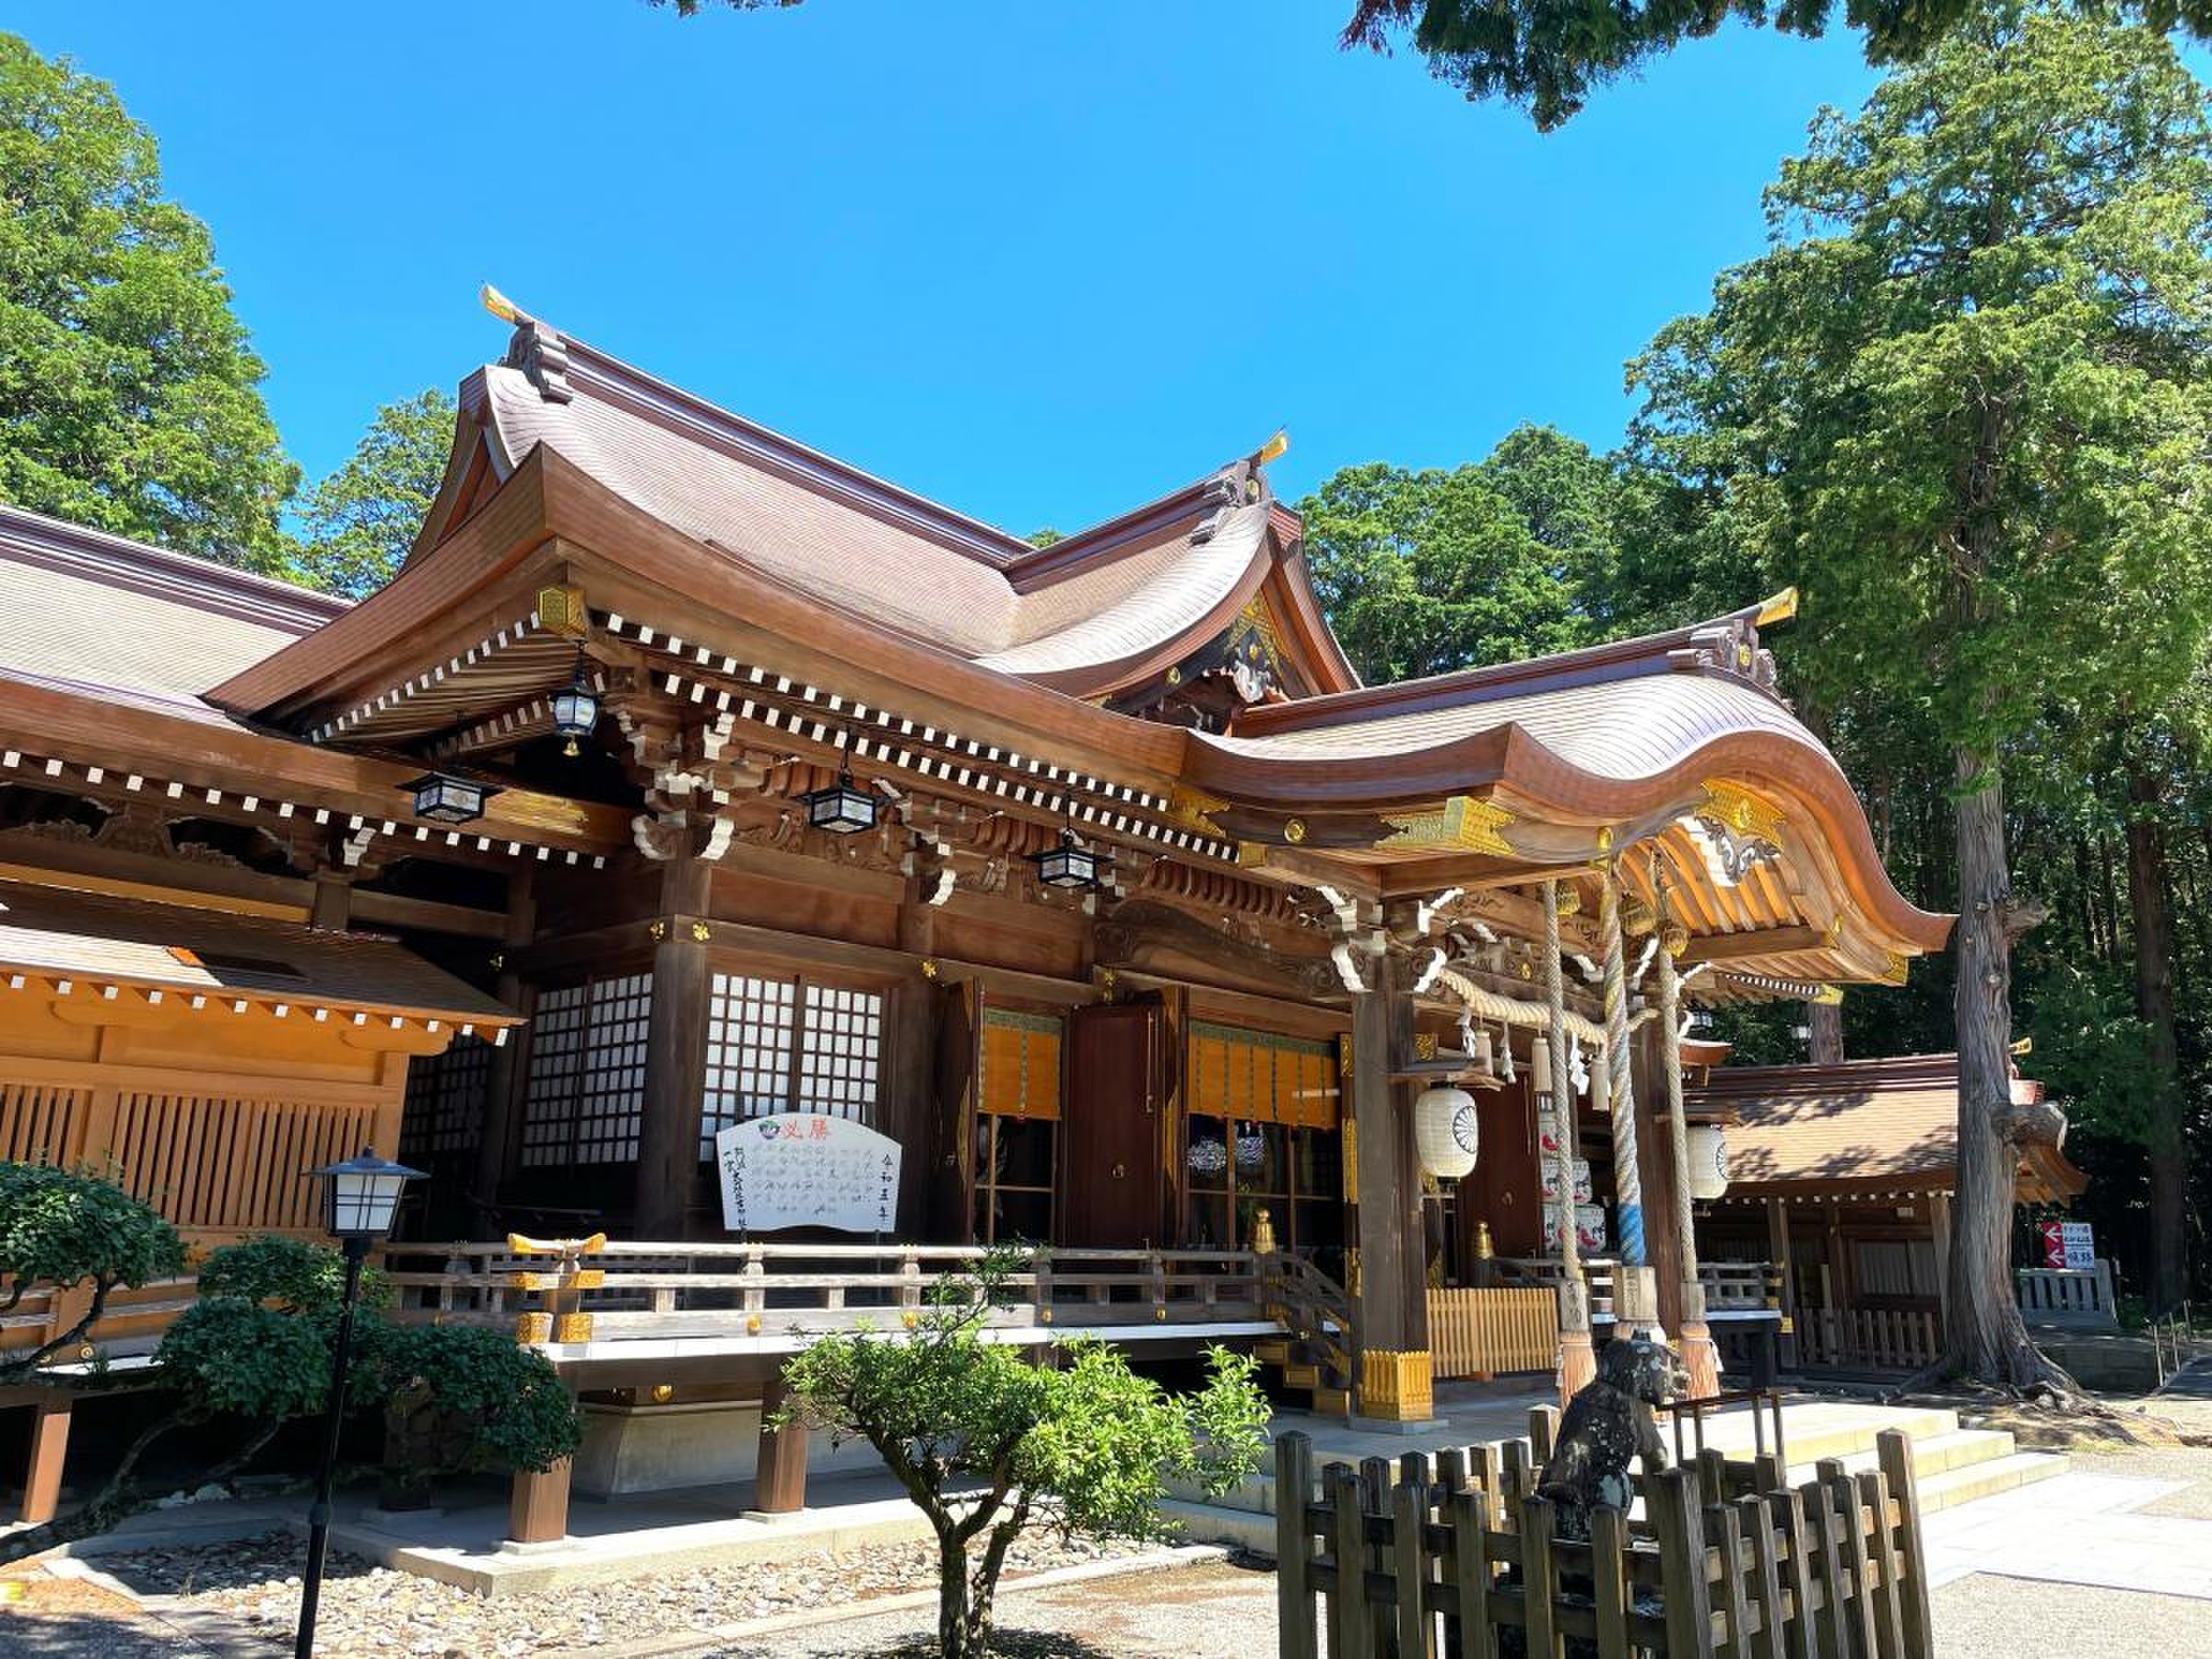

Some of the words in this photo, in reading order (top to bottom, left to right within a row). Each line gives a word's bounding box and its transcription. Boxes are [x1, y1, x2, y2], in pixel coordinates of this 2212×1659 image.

[782, 1120, 828, 1140] 必勝
[877, 1153, 893, 1222] 令和五年
